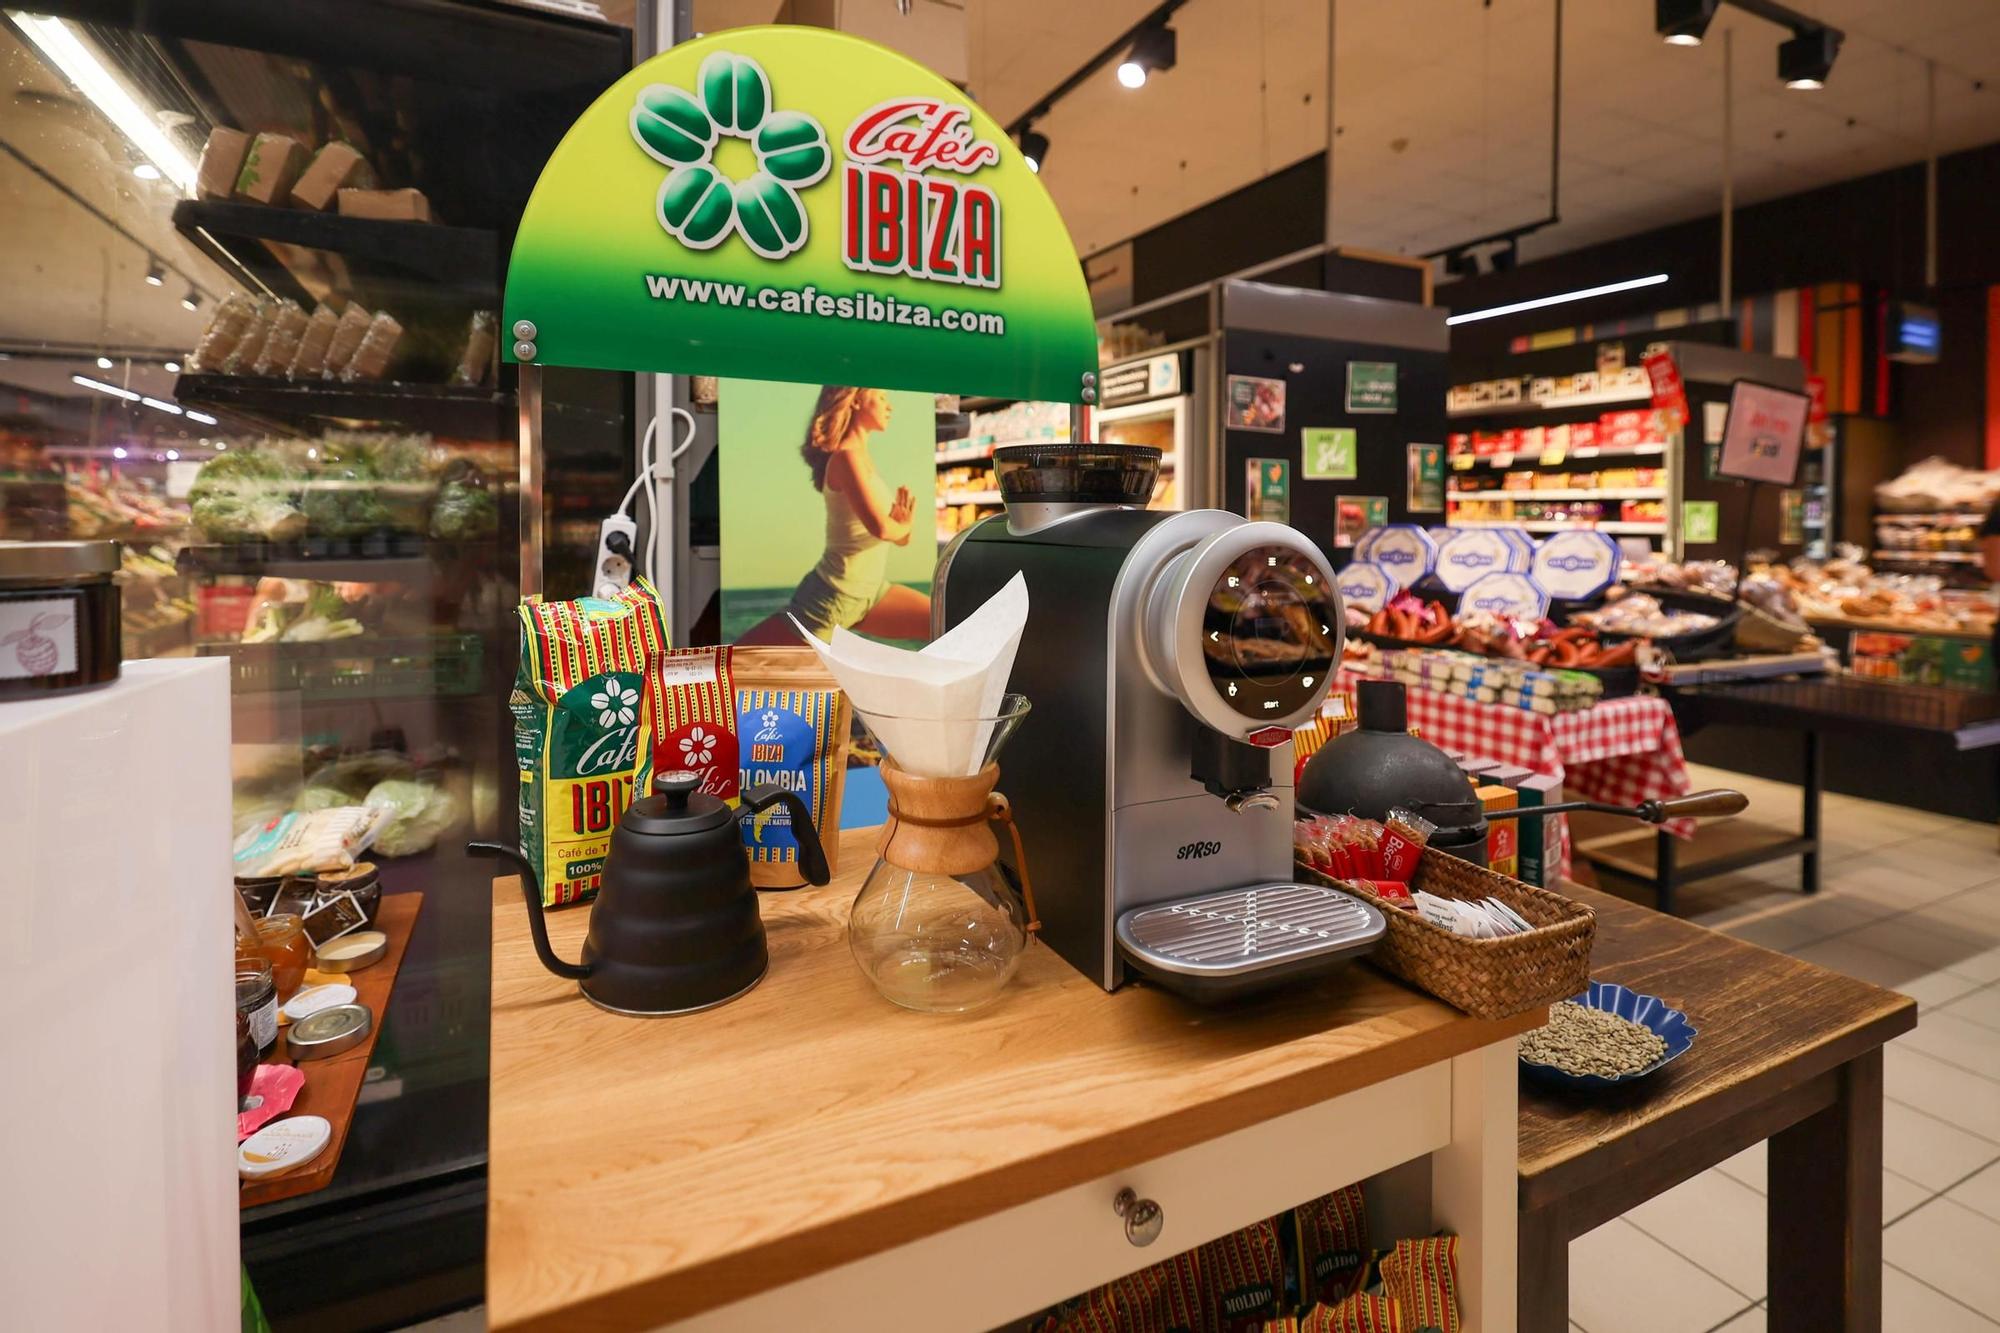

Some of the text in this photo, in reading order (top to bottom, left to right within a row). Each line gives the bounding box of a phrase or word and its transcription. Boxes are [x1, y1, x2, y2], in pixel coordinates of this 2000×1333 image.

[849, 102, 995, 166] Cafés
[847, 167, 996, 283] IBIZA
[645, 274, 1005, 335] www.cafesibiza.com
[1263, 700, 1280, 709] start
[754, 727, 784, 742] Cafés
[752, 743, 784, 763] IBIZA
[739, 768, 807, 791] OLOMBIA
[572, 775, 634, 835] IBI
[558, 848, 582, 858] Café
[585, 847, 598, 856] de
[1177, 841, 1222, 860] SPRSO
[569, 862, 602, 875] 100%
[1315, 1253, 1358, 1277] MOLIDO
[1224, 1288, 1272, 1313] MOLIDO
